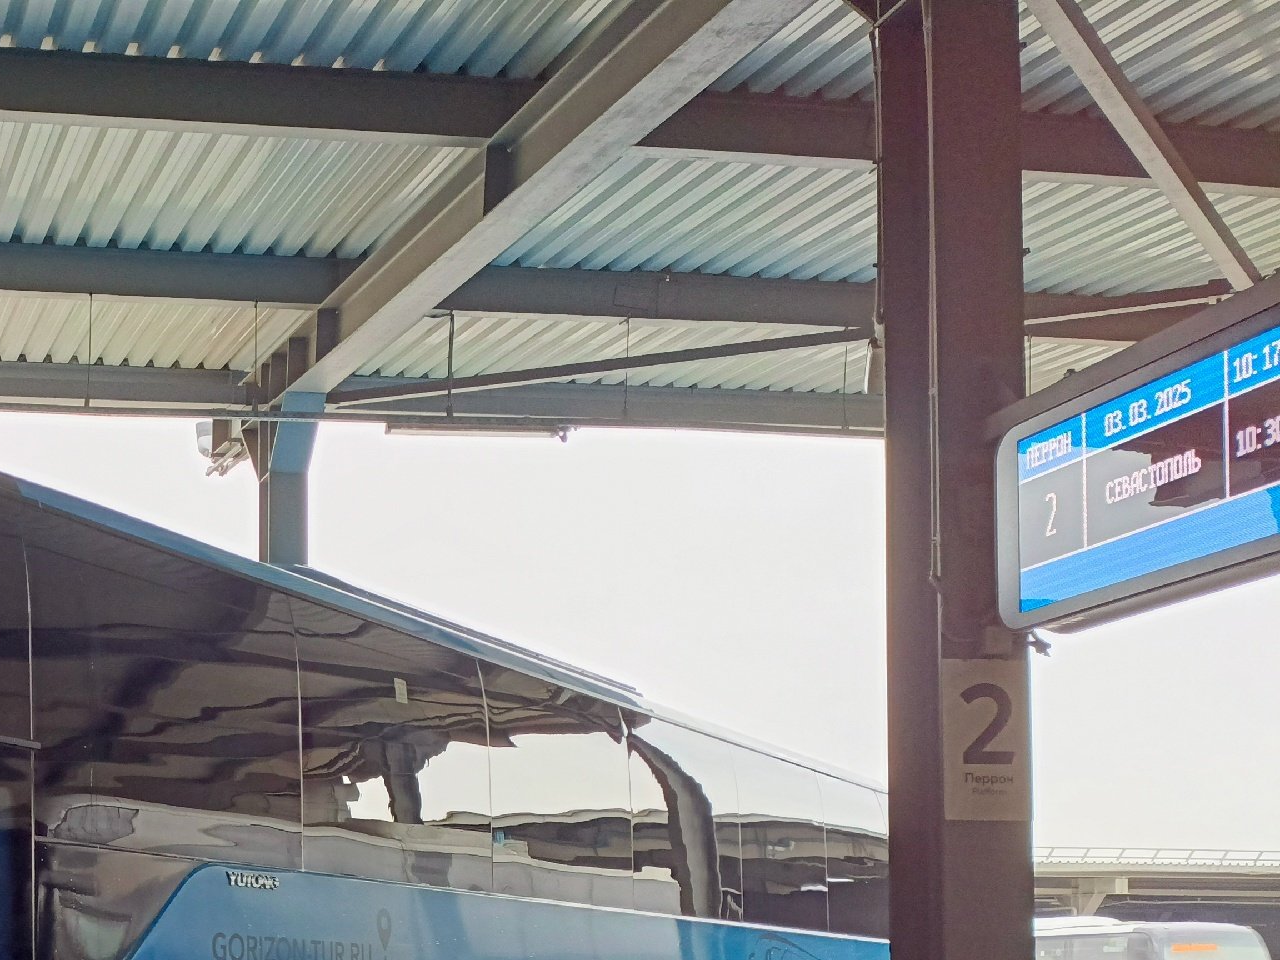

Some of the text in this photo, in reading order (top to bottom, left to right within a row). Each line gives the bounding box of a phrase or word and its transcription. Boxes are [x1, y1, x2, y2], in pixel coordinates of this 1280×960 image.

[1026, 430, 1072, 469] ПЕРРОН
[1105, 449, 1202, 504] СЕВАСТОПОЛЬ
[1045, 492, 1057, 537] 2
[960, 683, 1015, 764] 2
[965, 772, 1014, 787] Перрон
[226, 871, 280, 889] YUTONG
